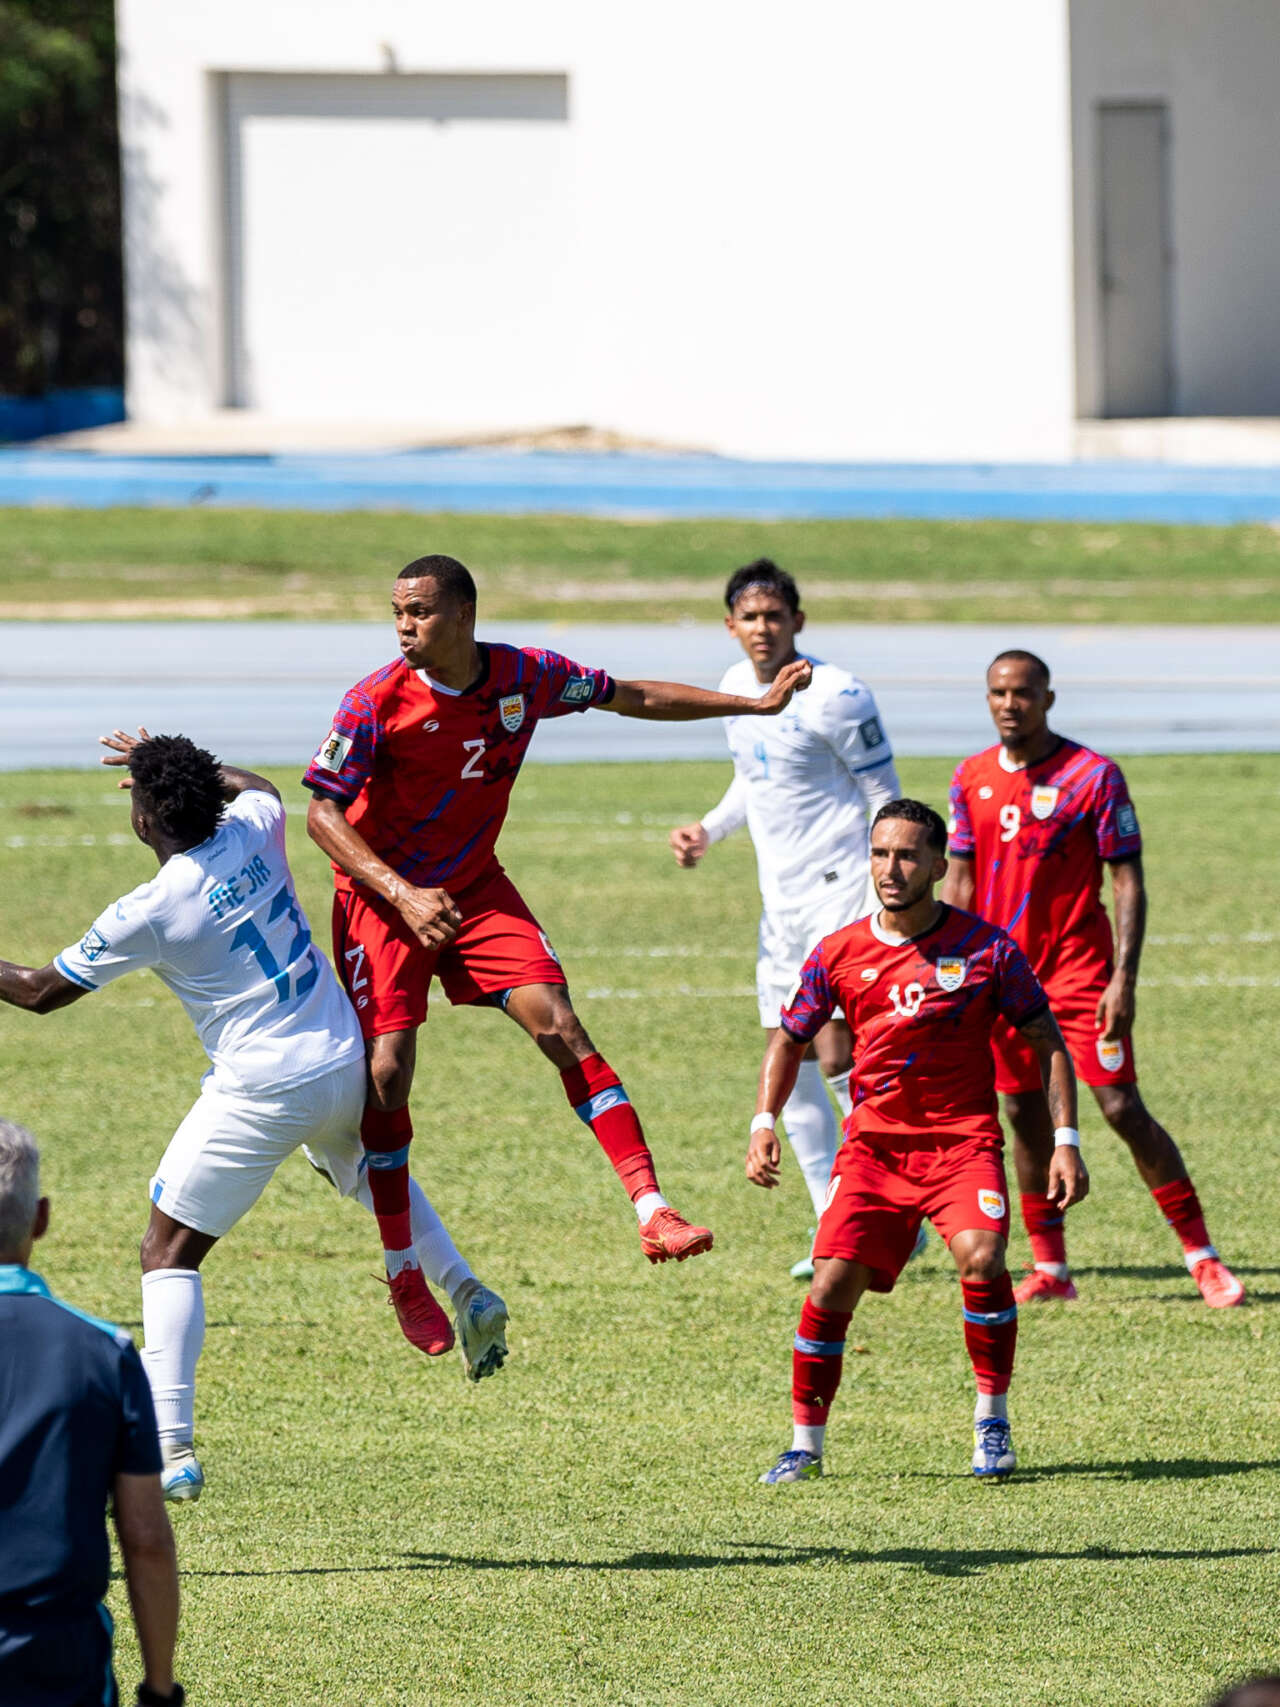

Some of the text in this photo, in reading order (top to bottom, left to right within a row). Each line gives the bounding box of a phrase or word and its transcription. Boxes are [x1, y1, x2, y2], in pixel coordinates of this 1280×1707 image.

[462, 738, 486, 780] 2
[999, 804, 1021, 843] 9
[208, 854, 272, 919] MEJIA
[229, 884, 319, 1004] 13
[345, 944, 368, 993] 2
[886, 982, 926, 1017] 10
